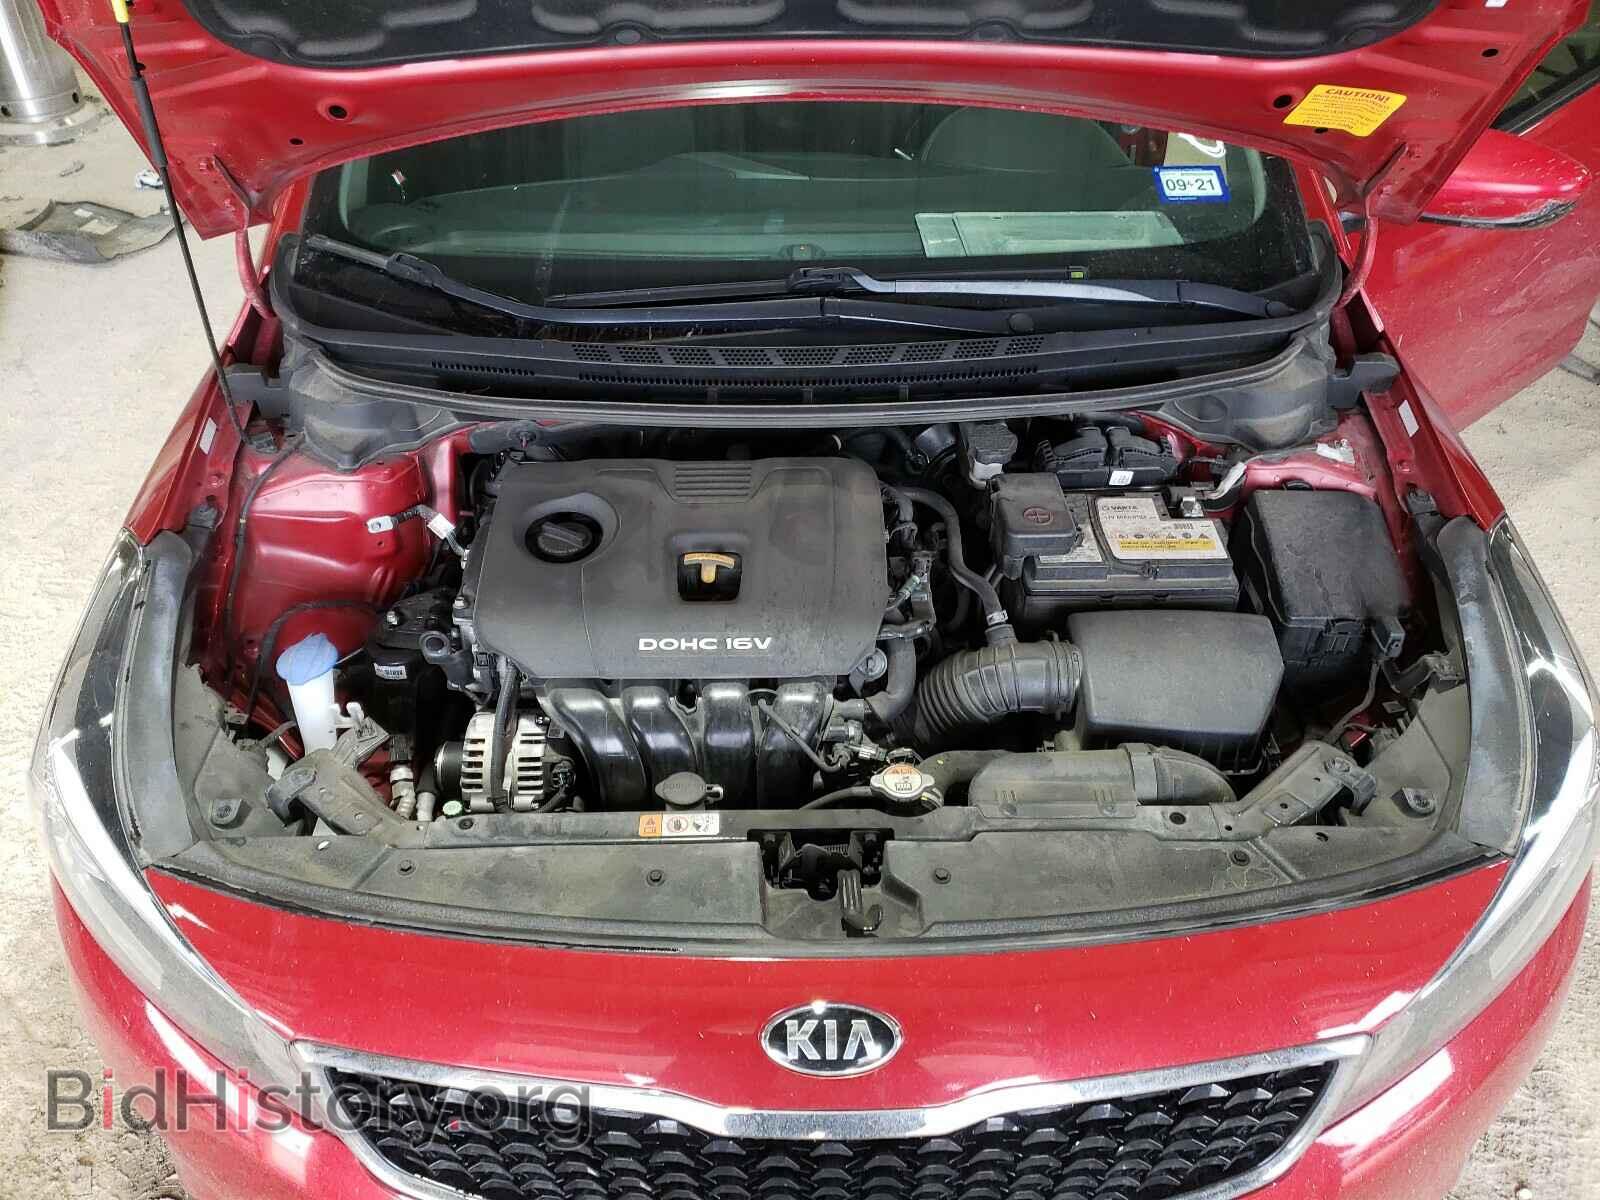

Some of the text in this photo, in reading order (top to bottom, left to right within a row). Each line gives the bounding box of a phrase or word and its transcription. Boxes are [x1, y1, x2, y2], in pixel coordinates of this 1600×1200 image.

[1325, 88, 1391, 103] CAUTION!
[1165, 178, 1215, 191] 09 21
[638, 636, 772, 651] DOHC 16V
[785, 1019, 882, 1061] KIA
